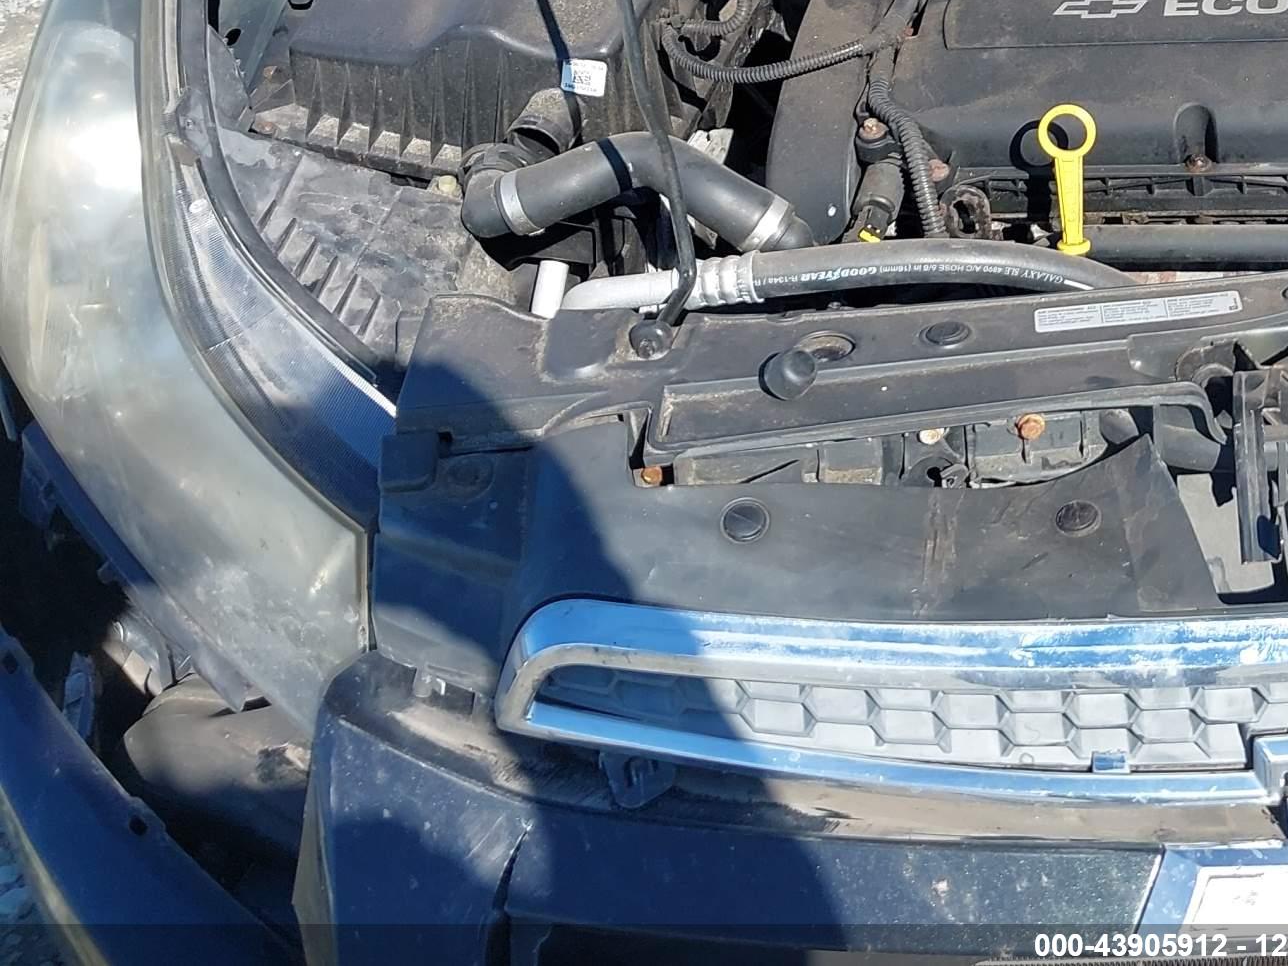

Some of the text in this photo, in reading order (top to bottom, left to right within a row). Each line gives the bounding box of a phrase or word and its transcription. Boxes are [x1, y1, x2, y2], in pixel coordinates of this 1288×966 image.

[800, 266, 878, 282] GOODYEAR
[938, 264, 964, 273] HOSE
[1022, 271, 1064, 283] GALAXY
